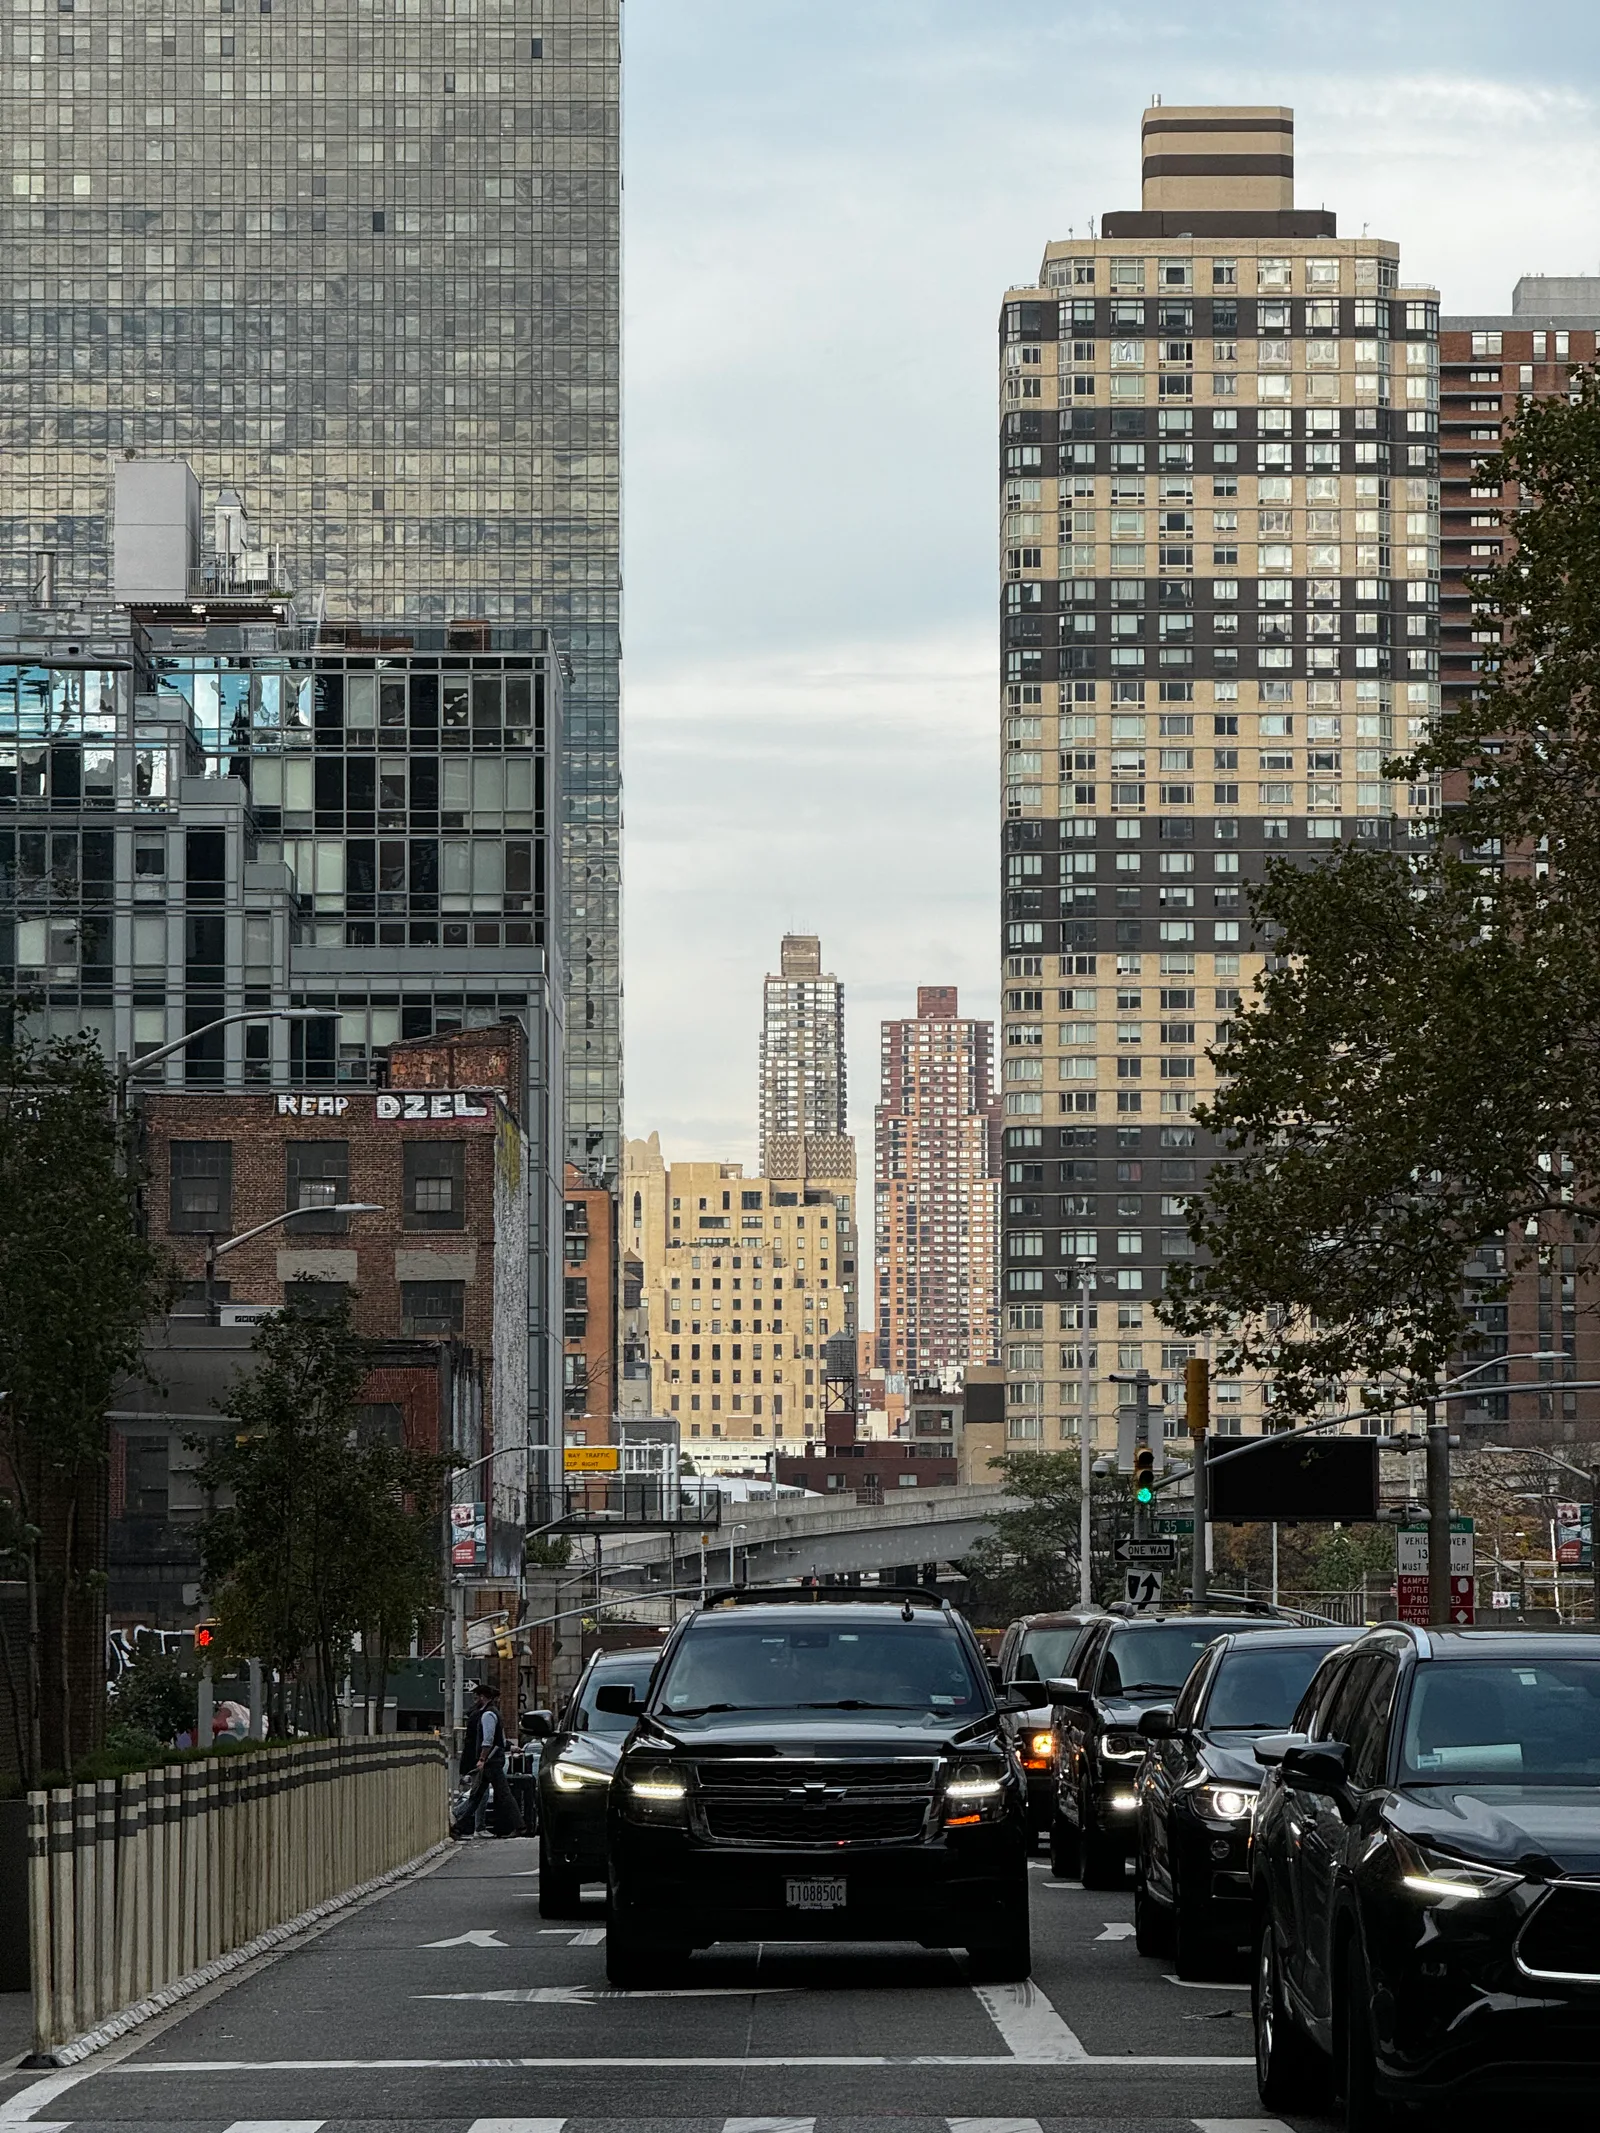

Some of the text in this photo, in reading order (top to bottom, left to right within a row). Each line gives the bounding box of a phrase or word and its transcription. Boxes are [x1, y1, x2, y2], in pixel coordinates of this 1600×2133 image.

[1152, 1521, 1160, 1533] W
[1164, 1520, 1177, 1533] 35
[1404, 1537, 1467, 1546] VEHIC VER
[1128, 1546, 1169, 1555] ONE WAY
[1402, 1563, 1422, 1571] MUST
[1402, 1586, 1429, 1594] BOTTLE
[1402, 1608, 1429, 1616] HAZAR
[789, 1885, 843, 1901] T108850C
